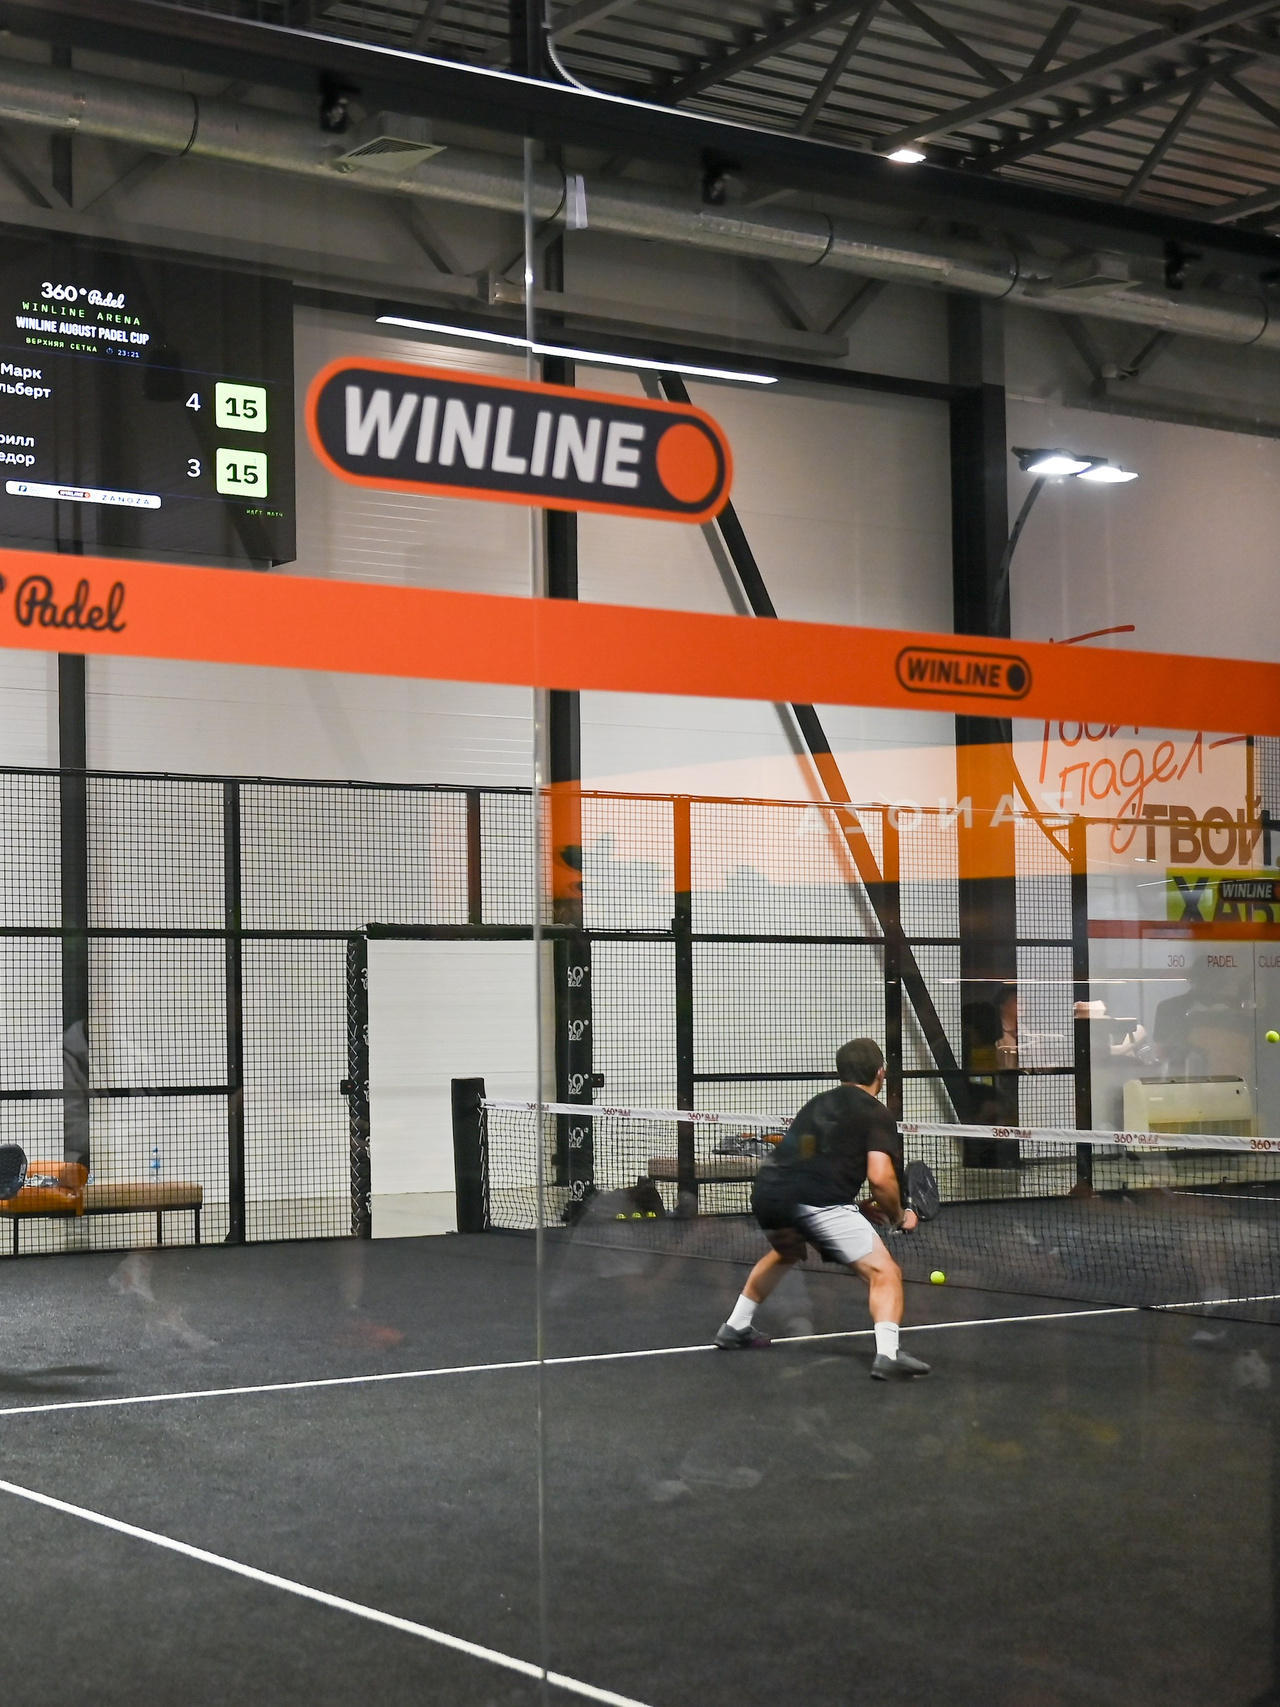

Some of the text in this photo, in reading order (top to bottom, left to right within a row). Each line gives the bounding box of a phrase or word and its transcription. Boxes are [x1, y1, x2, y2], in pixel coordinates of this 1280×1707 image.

[87, 289, 125, 309] Padel
[22, 301, 141, 326] WINLINE ARENA
[15, 315, 150, 345] WINLINE AUGUST PADEL CUP
[25, 337, 98, 352] ВЕРХНЯЯ СЕТКА
[117, 349, 140, 358] 23:21
[0, 362, 42, 380] Марк
[185, 392, 258, 419] 4 15
[345, 384, 646, 489] WINLINE
[186, 458, 259, 485] 3 15
[102, 494, 150, 505] ZANOZA
[16, 575, 127, 632] Padel
[908, 657, 1001, 687] WINLINE
[1222, 884, 1272, 898] WINLINE
[1167, 954, 1185, 968] 360
[1207, 955, 1237, 968] PADEL
